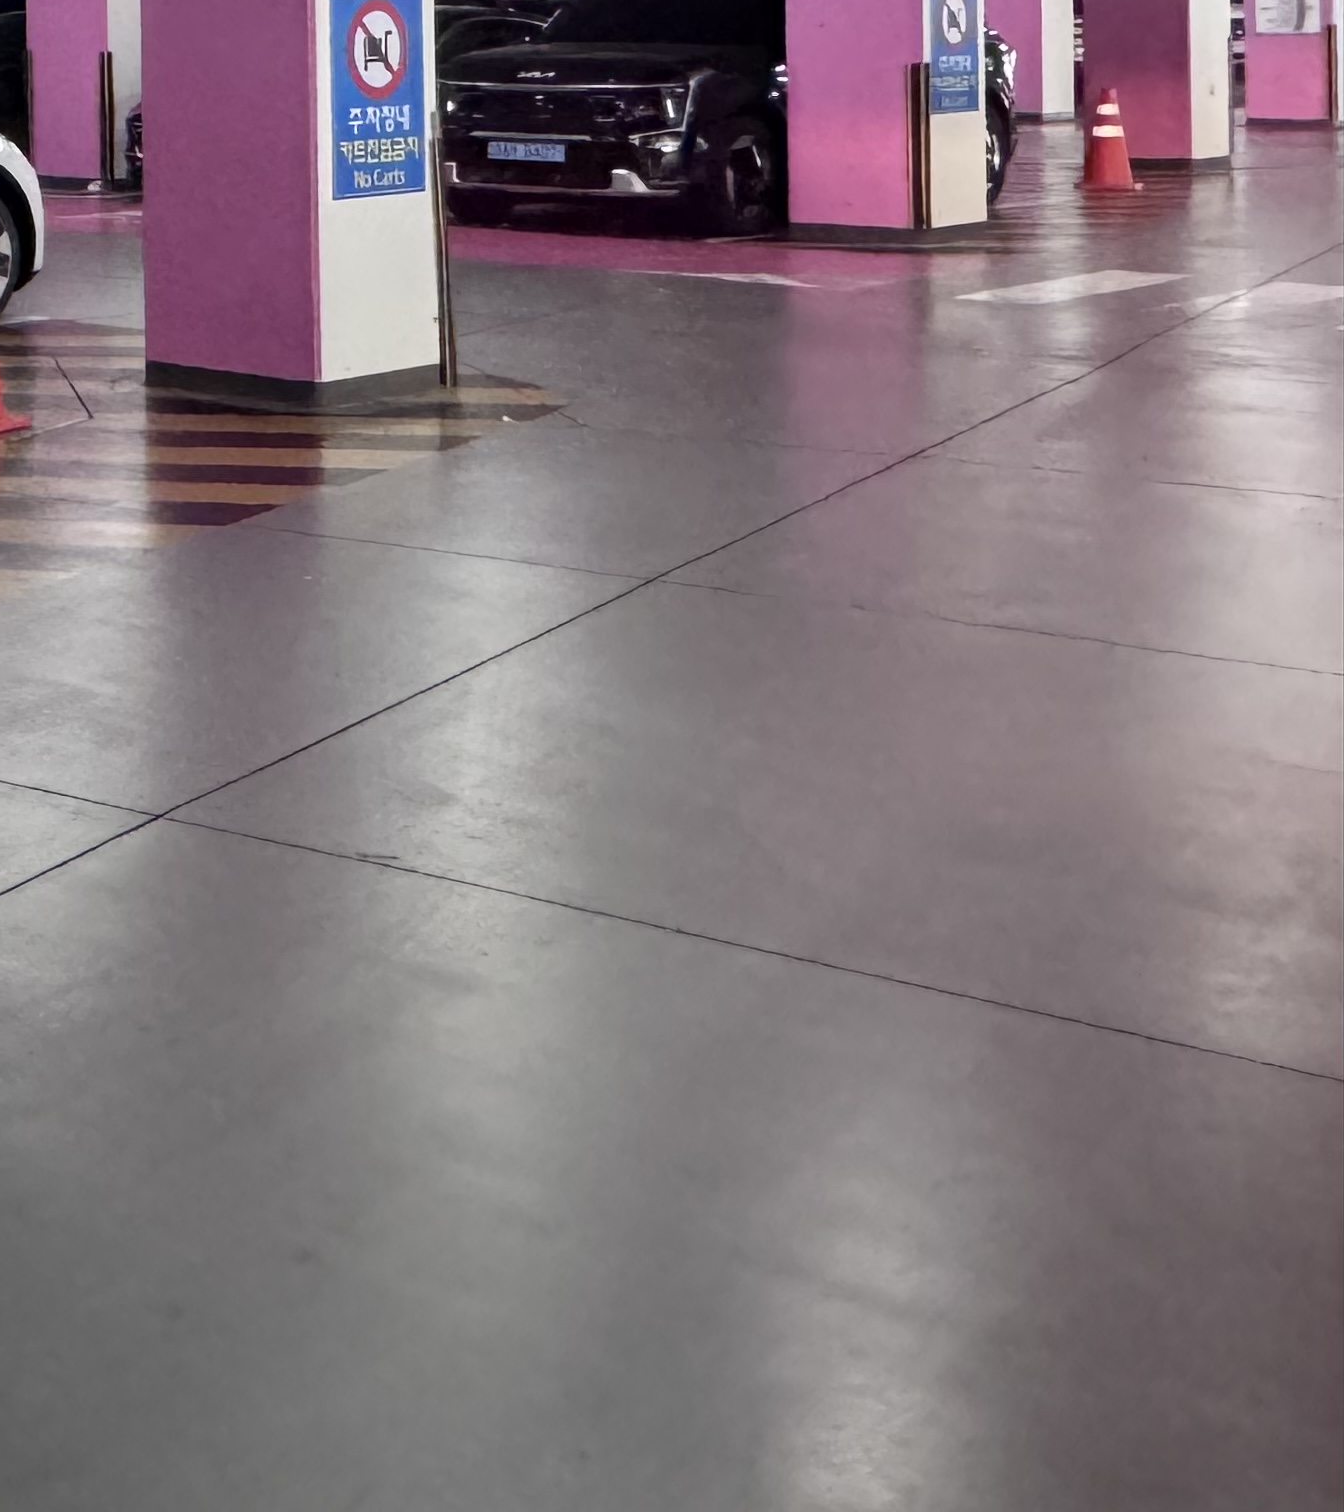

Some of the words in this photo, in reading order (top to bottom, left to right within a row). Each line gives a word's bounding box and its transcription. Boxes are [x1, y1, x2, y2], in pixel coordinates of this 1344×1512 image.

[348, 104, 411, 135] 주차장내
[354, 169, 372, 189] No
[373, 167, 406, 186] Carts
